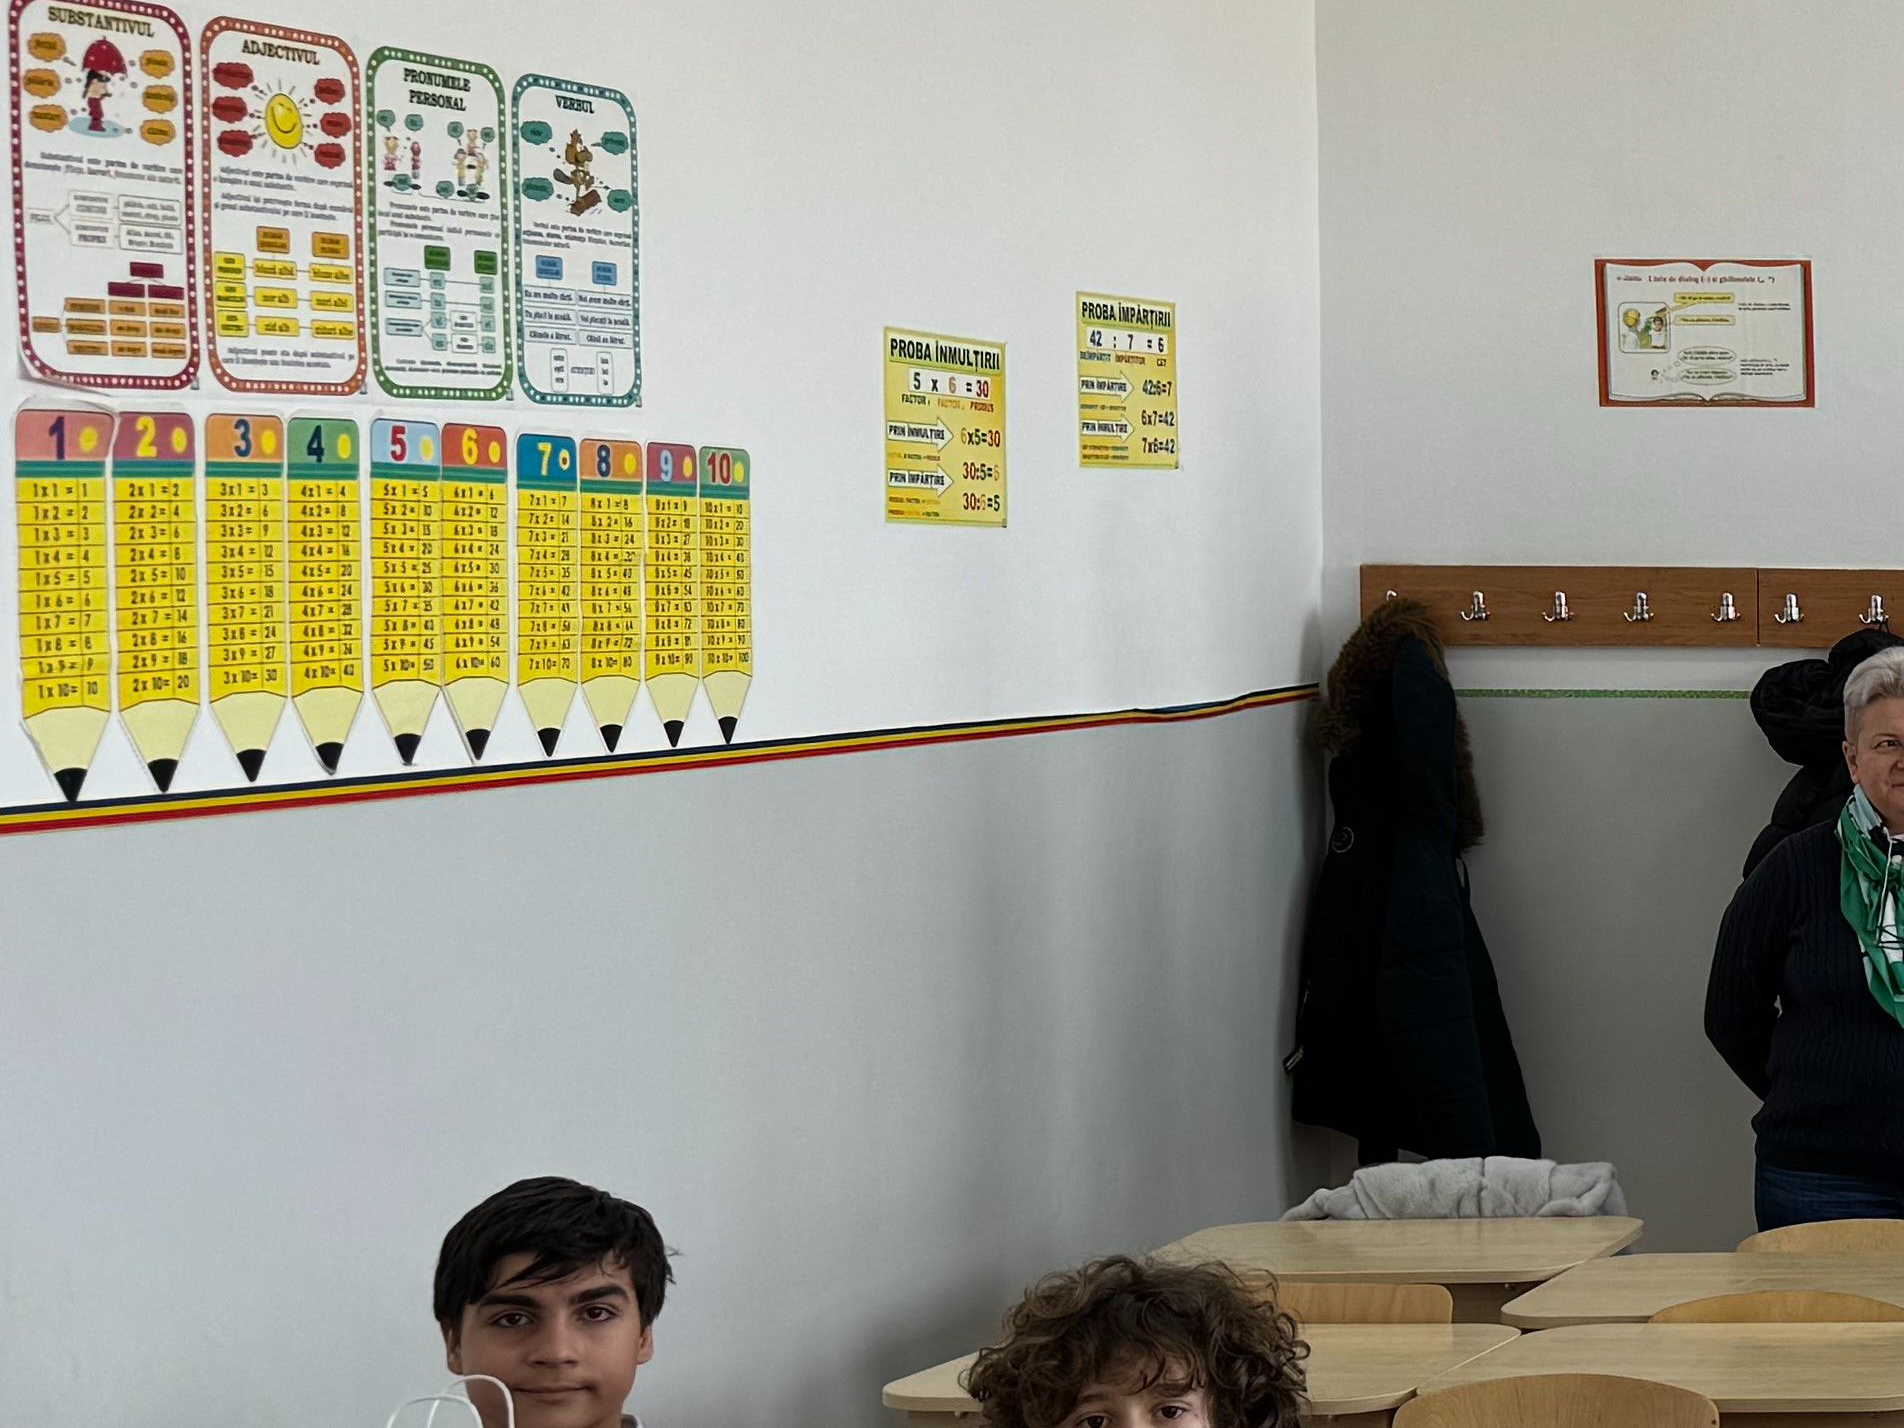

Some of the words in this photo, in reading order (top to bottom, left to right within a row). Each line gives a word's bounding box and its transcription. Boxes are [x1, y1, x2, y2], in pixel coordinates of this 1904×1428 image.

[48, 6, 155, 39] SUBSTANTIVUL
[241, 39, 321, 65] ADJECTIVUL
[403, 67, 471, 92] PRONUMELE
[408, 89, 467, 111] PERSONAL
[555, 95, 595, 114] VERBUL
[1082, 301, 1116, 321] PROBA
[890, 338, 932, 362] PROBA
[1089, 330, 1102, 347] 42
[1127, 334, 1134, 349] 7
[1157, 337, 1165, 352] 6
[913, 372, 921, 390] 5
[948, 376, 957, 393] 6
[976, 380, 989, 398] 30
[1141, 410, 1175, 427] 6x7=42
[48, 415, 66, 460] 1
[135, 416, 157, 457] 2
[233, 418, 252, 458] 3
[306, 424, 325, 463] 4
[390, 425, 408, 462] 5
[461, 428, 480, 465] 6
[960, 427, 1001, 448] 6x5=30
[1142, 437, 1175, 454] 7x6=42
[537, 442, 552, 476] 7
[596, 444, 611, 477] 8
[660, 449, 673, 482] 9
[707, 452, 731, 484] 10
